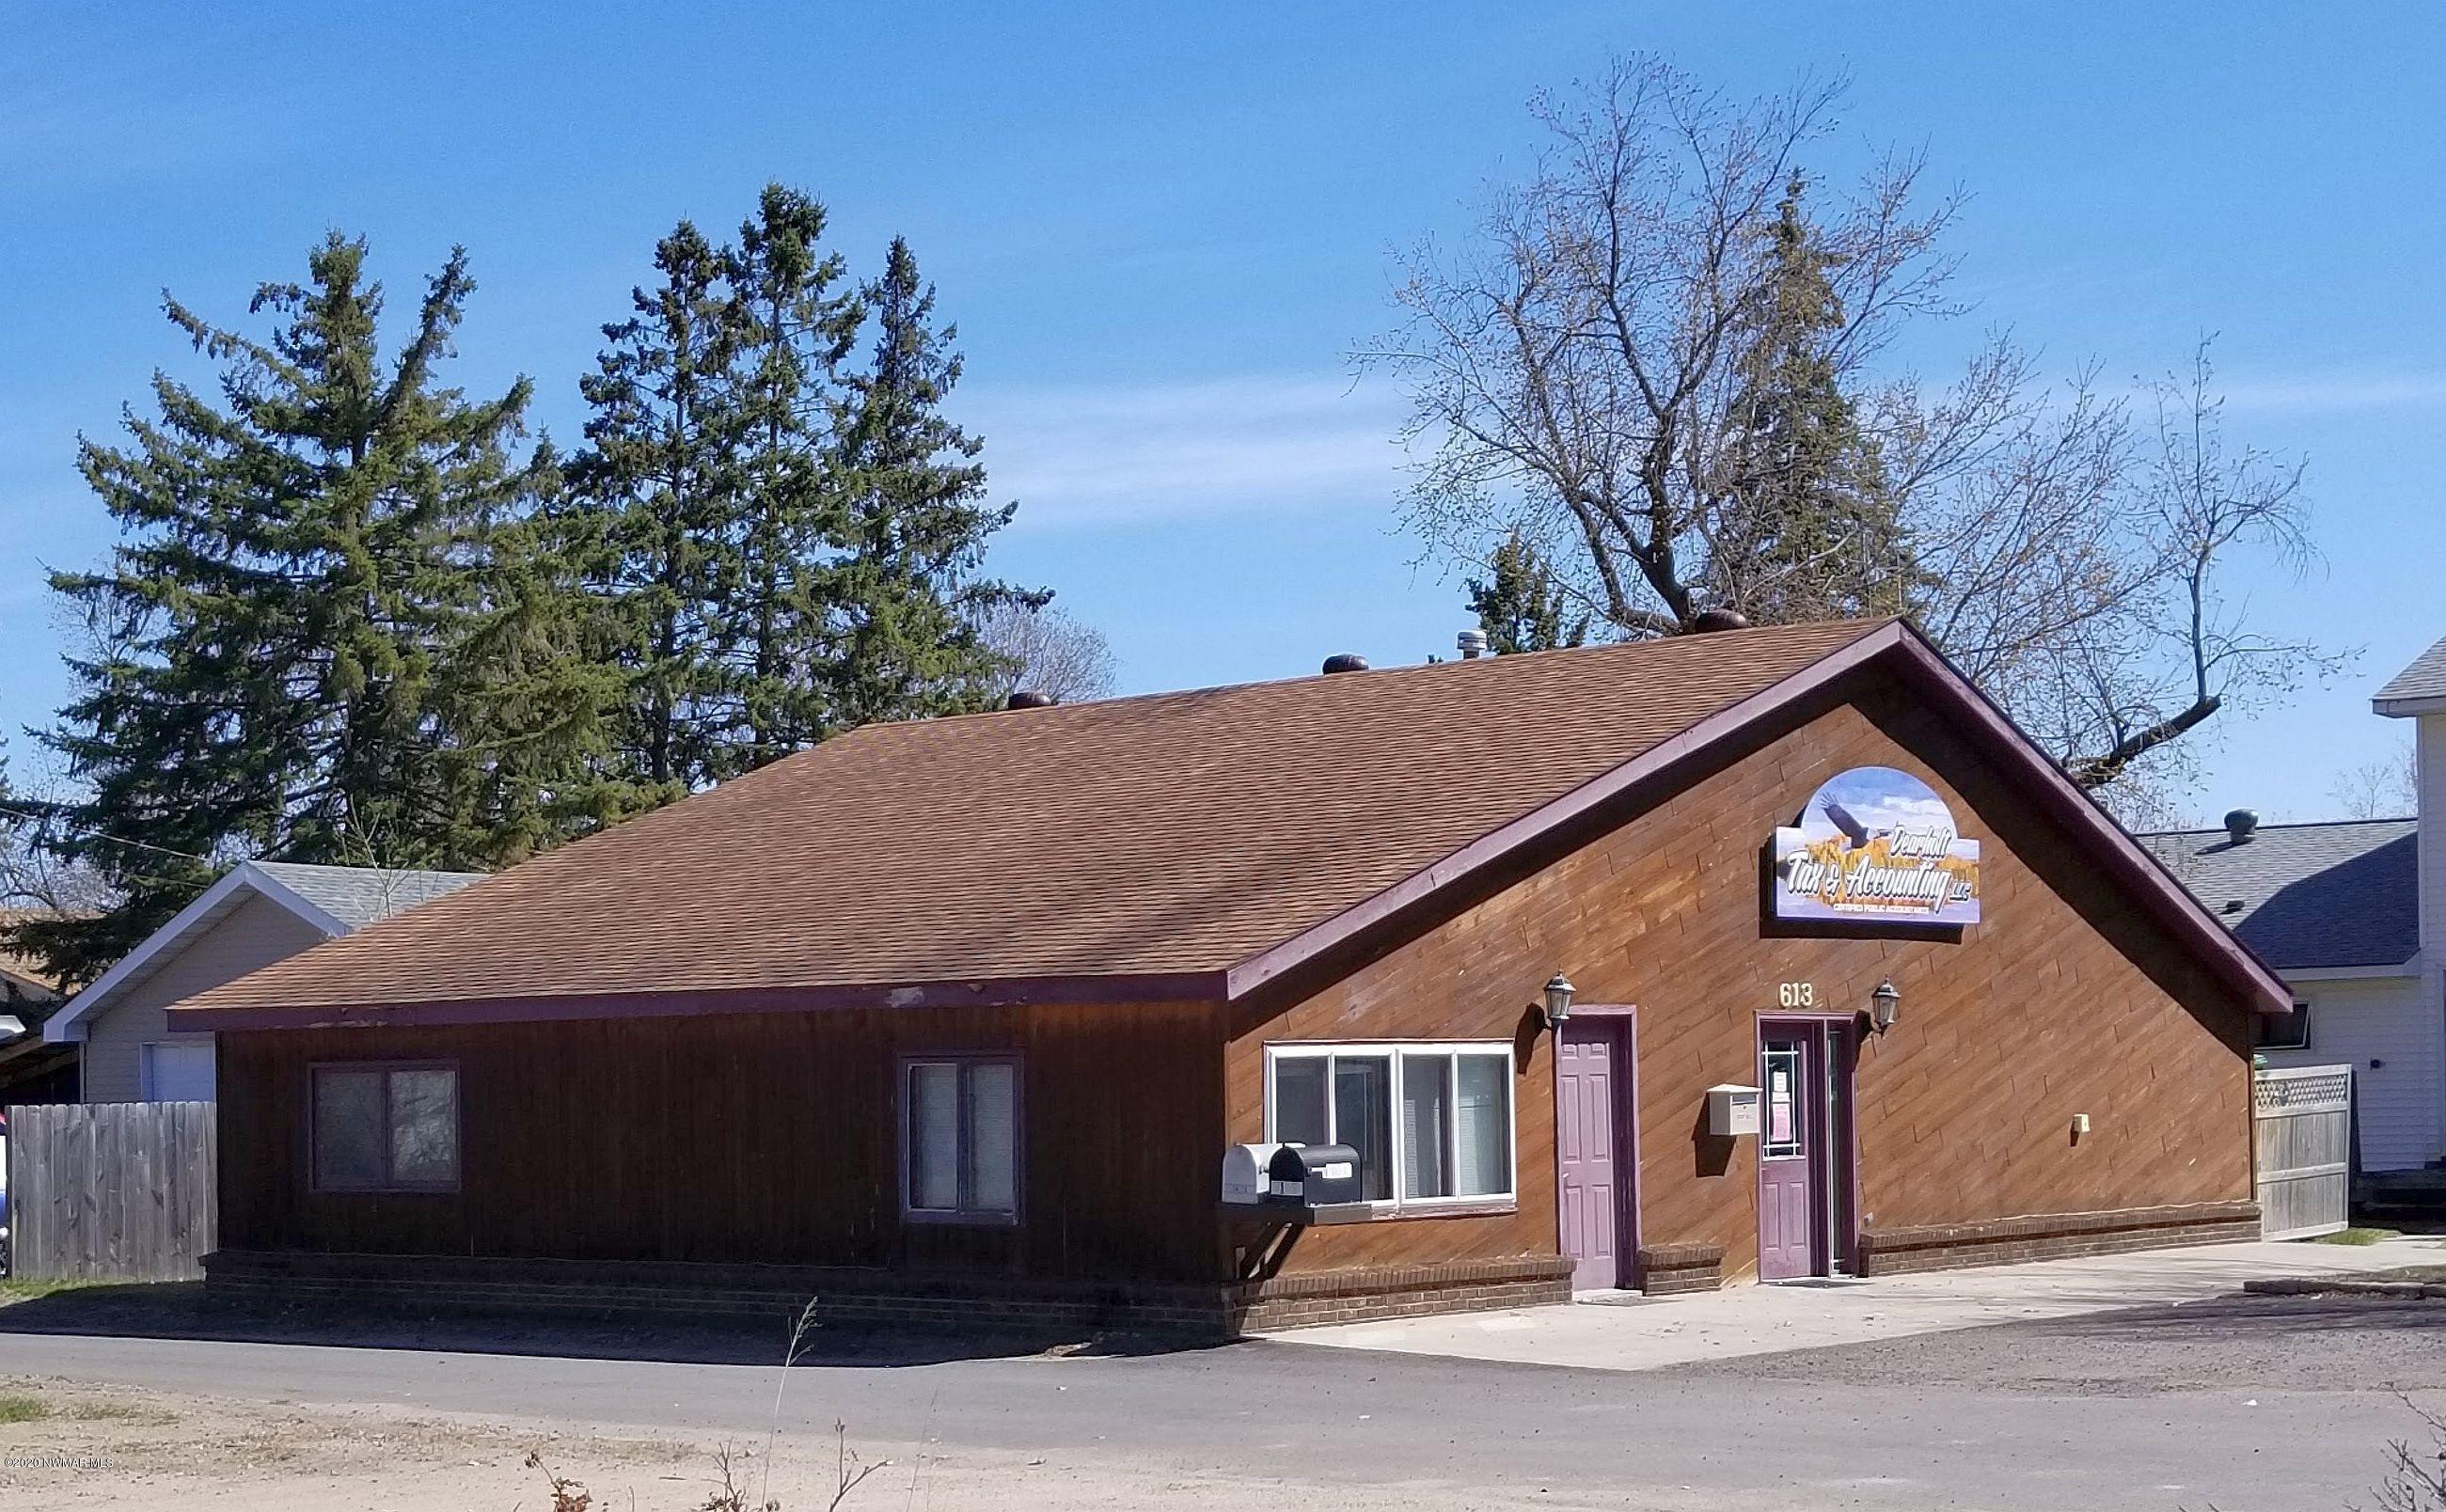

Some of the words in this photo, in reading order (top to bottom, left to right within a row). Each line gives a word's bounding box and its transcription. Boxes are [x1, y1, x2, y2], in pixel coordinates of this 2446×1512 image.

[1788, 850, 1823, 894] Tax
[1826, 863, 1840, 896] &
[1846, 854, 1952, 914] Accounting
[1779, 983, 1813, 1007] 613
